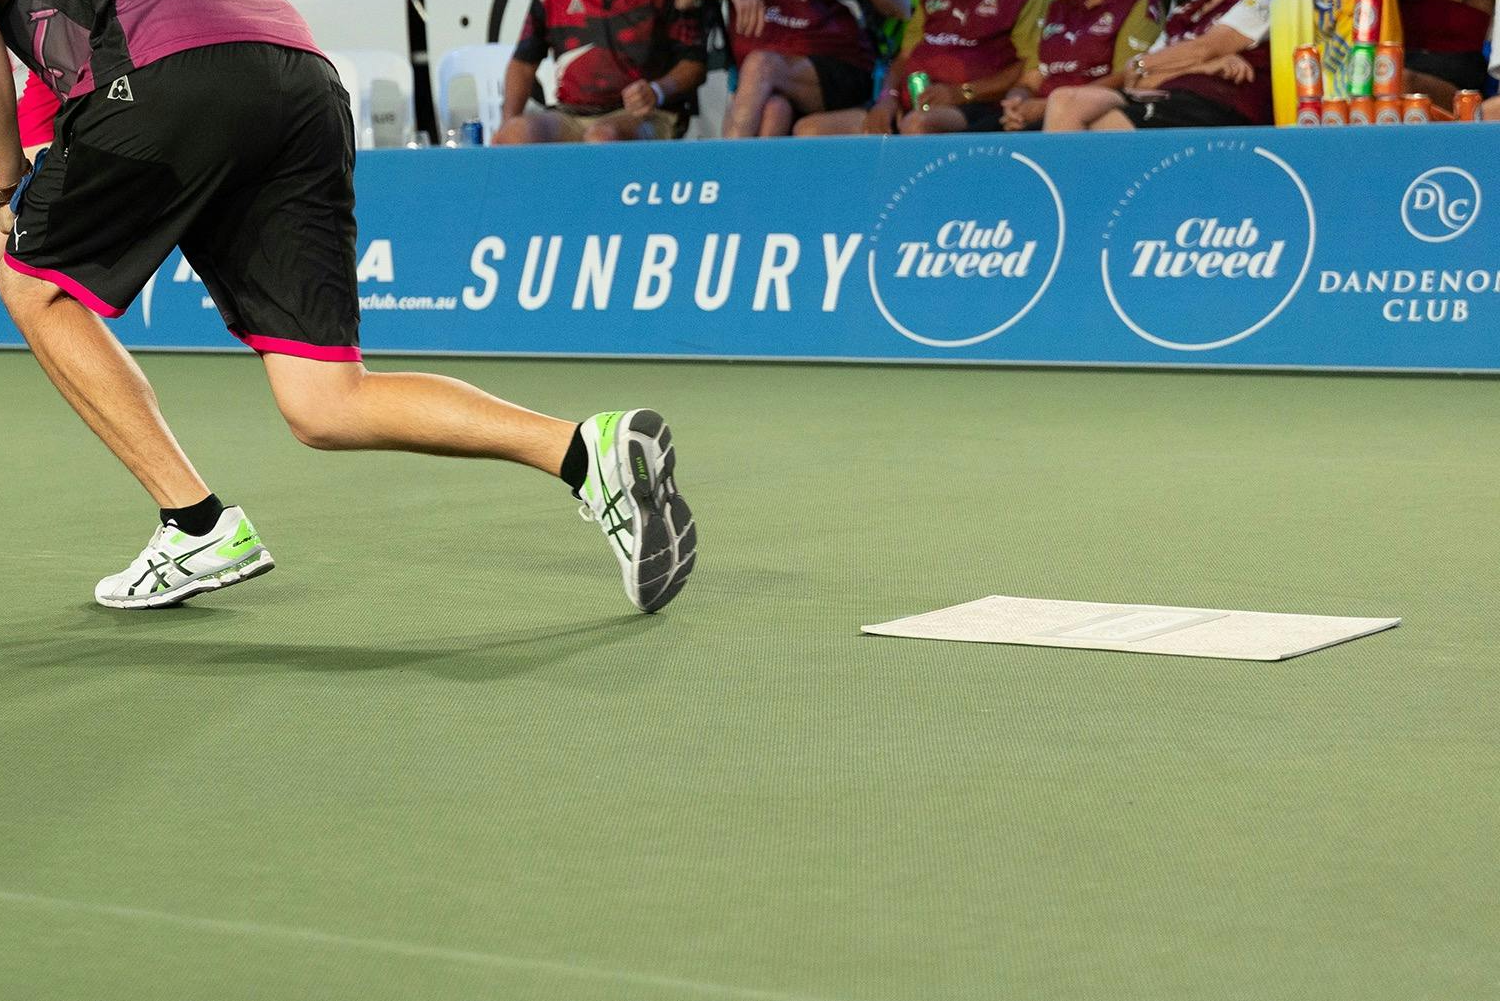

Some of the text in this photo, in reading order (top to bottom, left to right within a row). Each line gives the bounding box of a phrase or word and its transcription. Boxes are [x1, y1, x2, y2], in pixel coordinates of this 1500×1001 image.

[621, 180, 720, 206] CLUB
[937, 220, 1014, 250] Club
[1175, 217, 1259, 248] Club
[462, 233, 863, 312] SUNBURY
[895, 240, 1037, 278] Tweed
[1130, 239, 1285, 279] Tweed
[1382, 299, 1469, 323] CLUB
